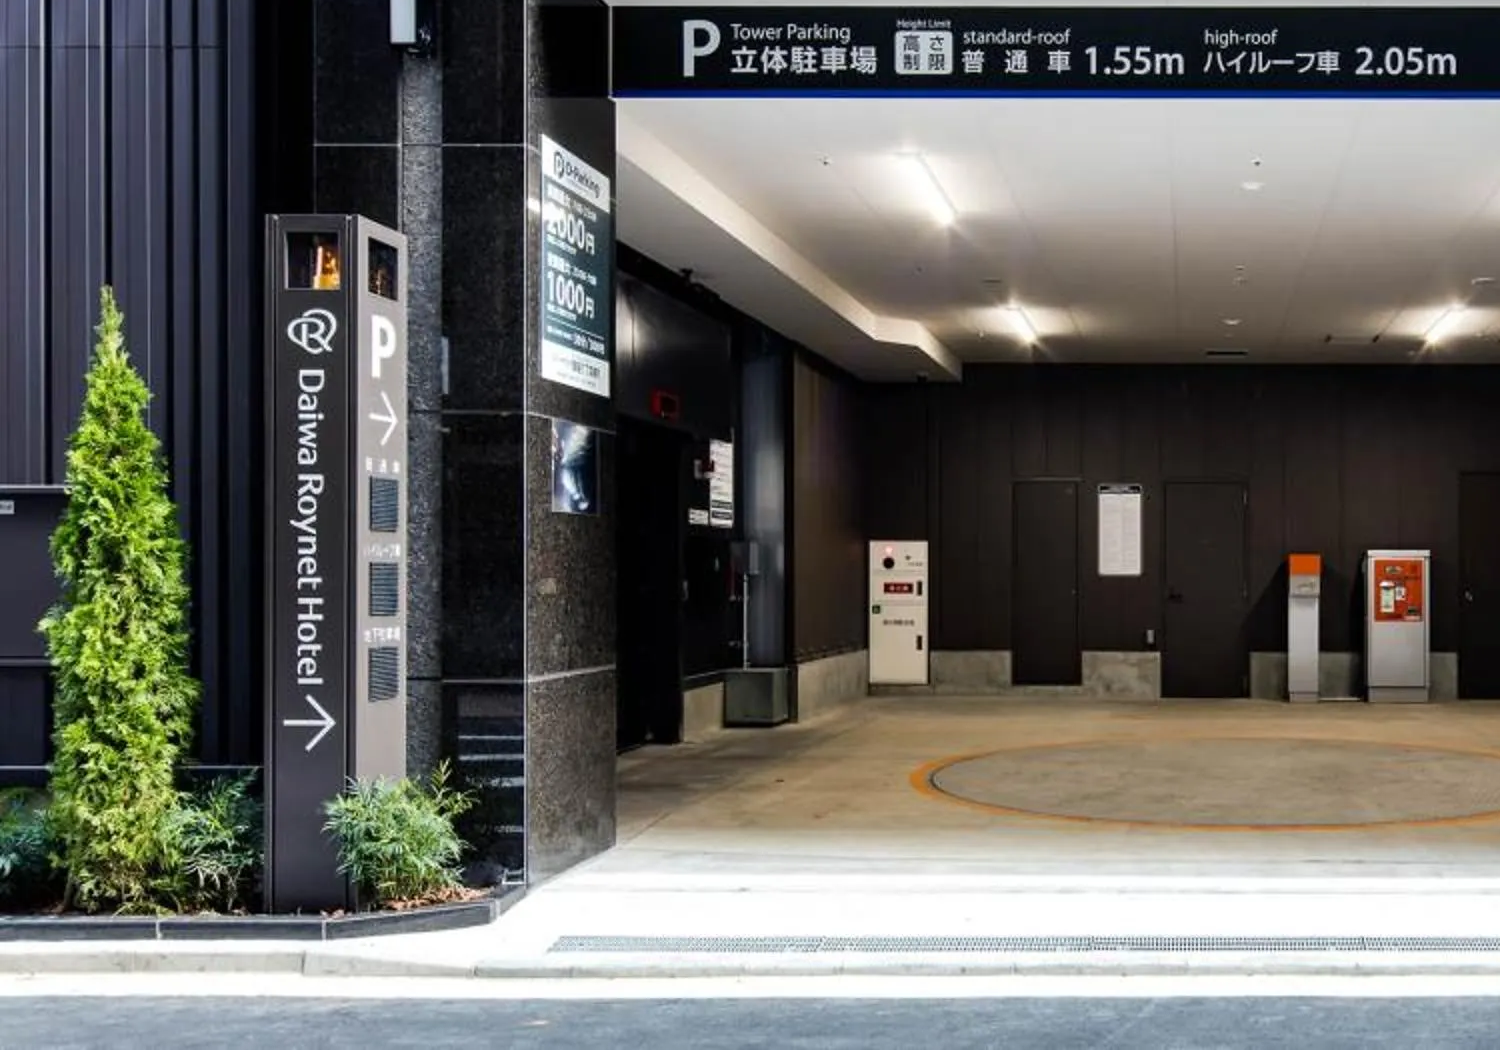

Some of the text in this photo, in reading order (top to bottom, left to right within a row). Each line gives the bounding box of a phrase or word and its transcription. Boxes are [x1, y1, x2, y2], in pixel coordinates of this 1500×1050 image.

[683, 20, 721, 77] P
[730, 23, 851, 45] Tower Parking
[963, 28, 1071, 45] standard-roof
[1204, 28, 1279, 49] high-roof
[730, 45, 878, 75] 立体駐車場
[1085, 45, 1185, 75] 1.55m
[1203, 46, 1457, 76] ハイルーフ車 2.05m
[371, 314, 397, 378] P
[289, 369, 325, 685] Daiwa Roynet Hotel
